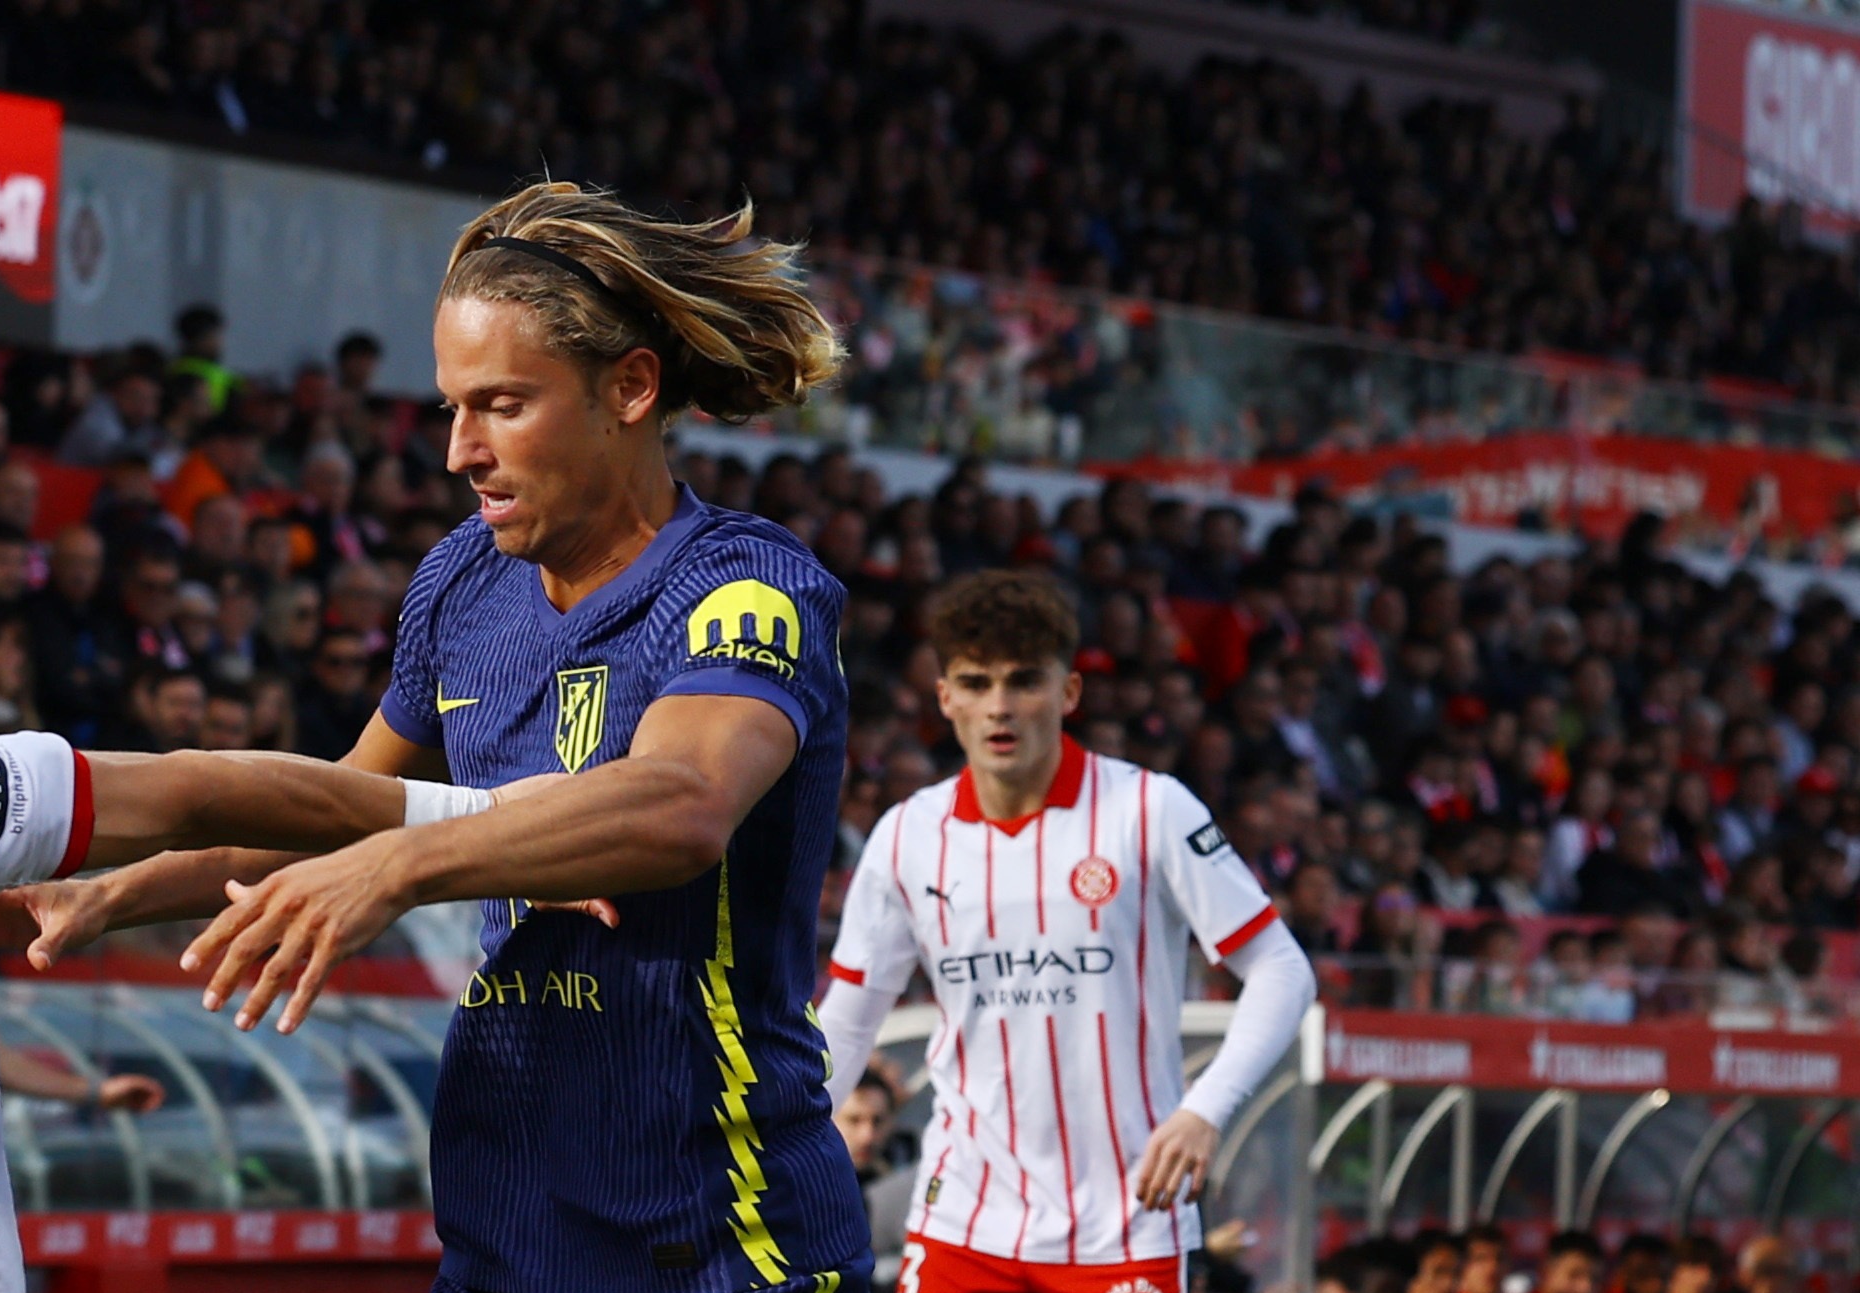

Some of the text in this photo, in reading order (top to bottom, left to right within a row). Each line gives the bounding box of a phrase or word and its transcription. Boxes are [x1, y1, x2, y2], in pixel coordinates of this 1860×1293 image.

[939, 946, 1115, 983] ETIHAD
[541, 970, 603, 1012] AIR
[973, 987, 1077, 1009] AIRWAYS
